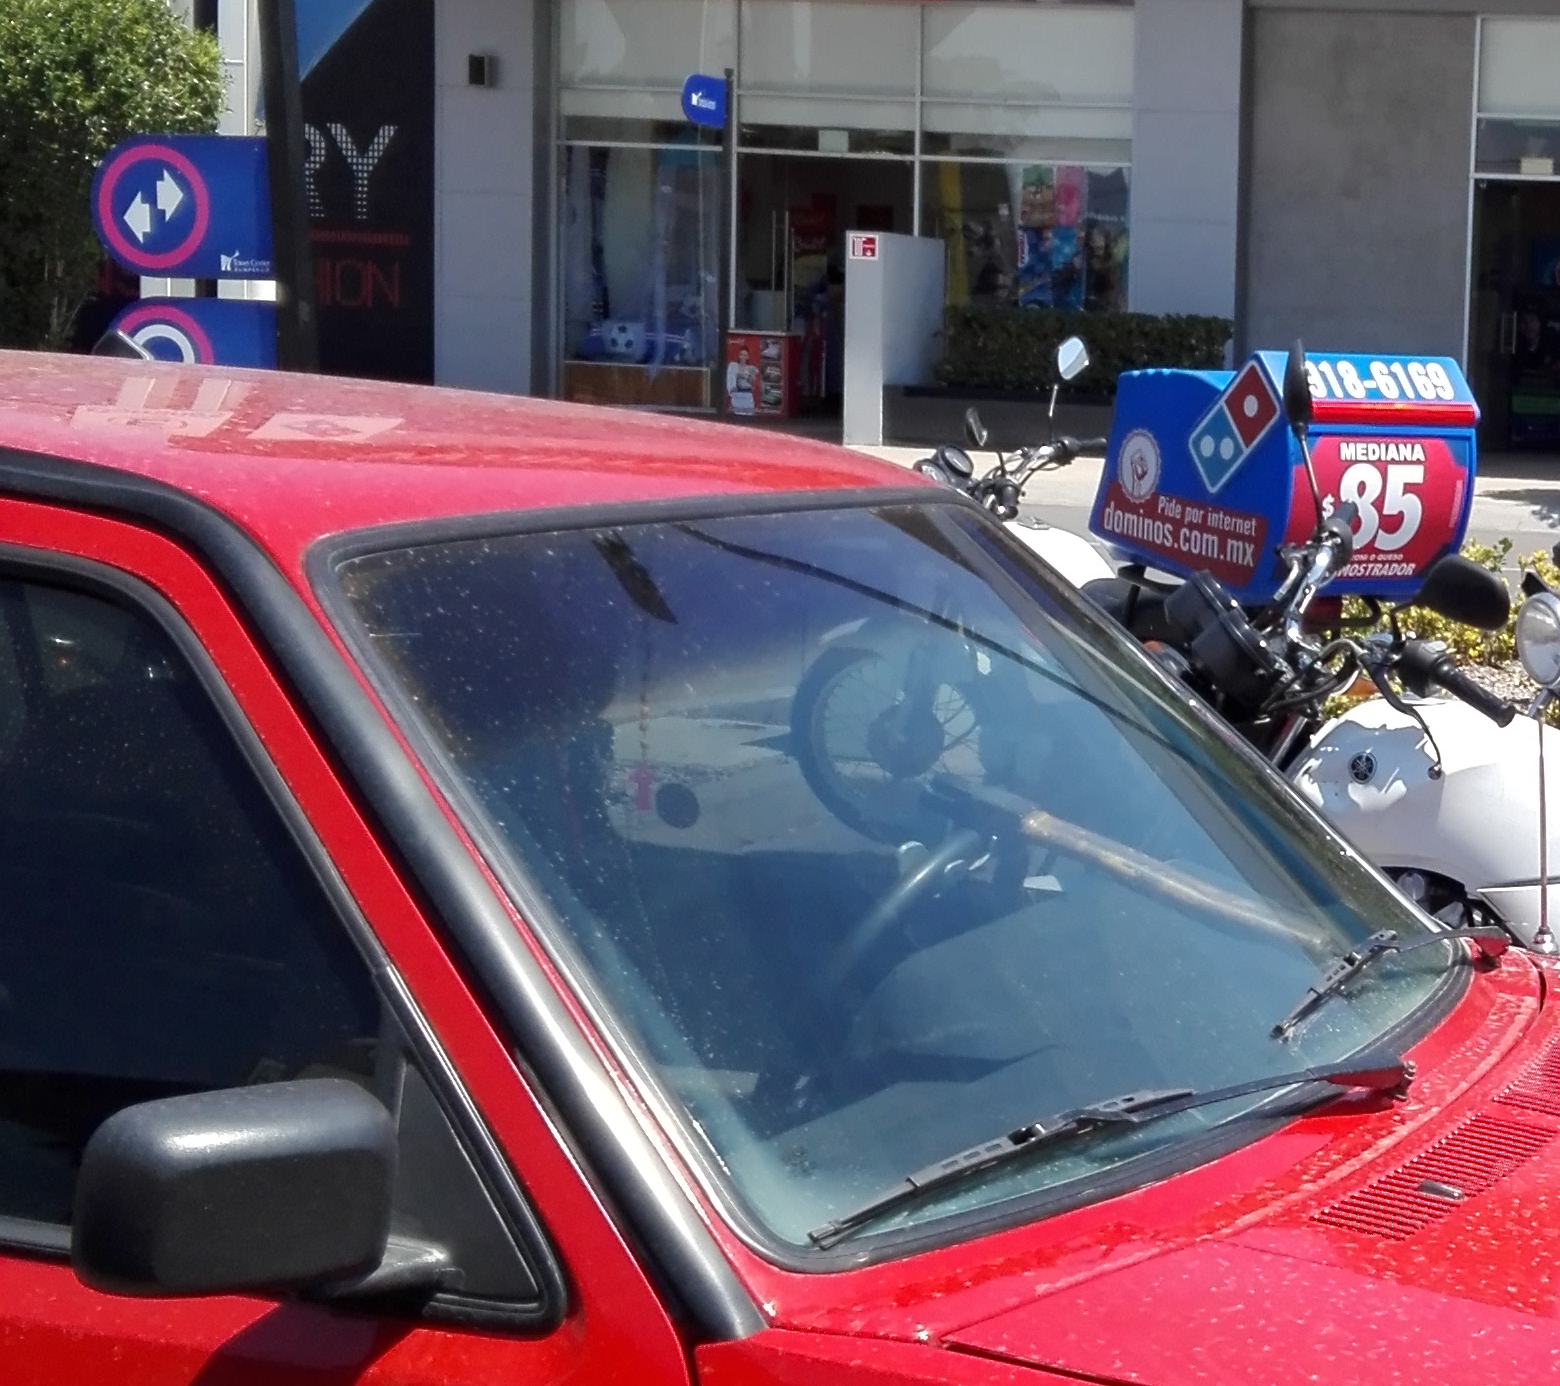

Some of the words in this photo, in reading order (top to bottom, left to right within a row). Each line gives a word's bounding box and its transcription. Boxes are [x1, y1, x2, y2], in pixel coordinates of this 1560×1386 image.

[1305, 360, 1455, 401] 918-6169
[1339, 441, 1426, 462] MEDIANA
[1158, 495, 1181, 519] Pide
[1185, 507, 1204, 525] por
[1208, 508, 1257, 537] internet
[1339, 463, 1425, 551] 85
[1104, 501, 1255, 567] dominos.com.mx
[1337, 562, 1416, 577] MOSTRADOR
